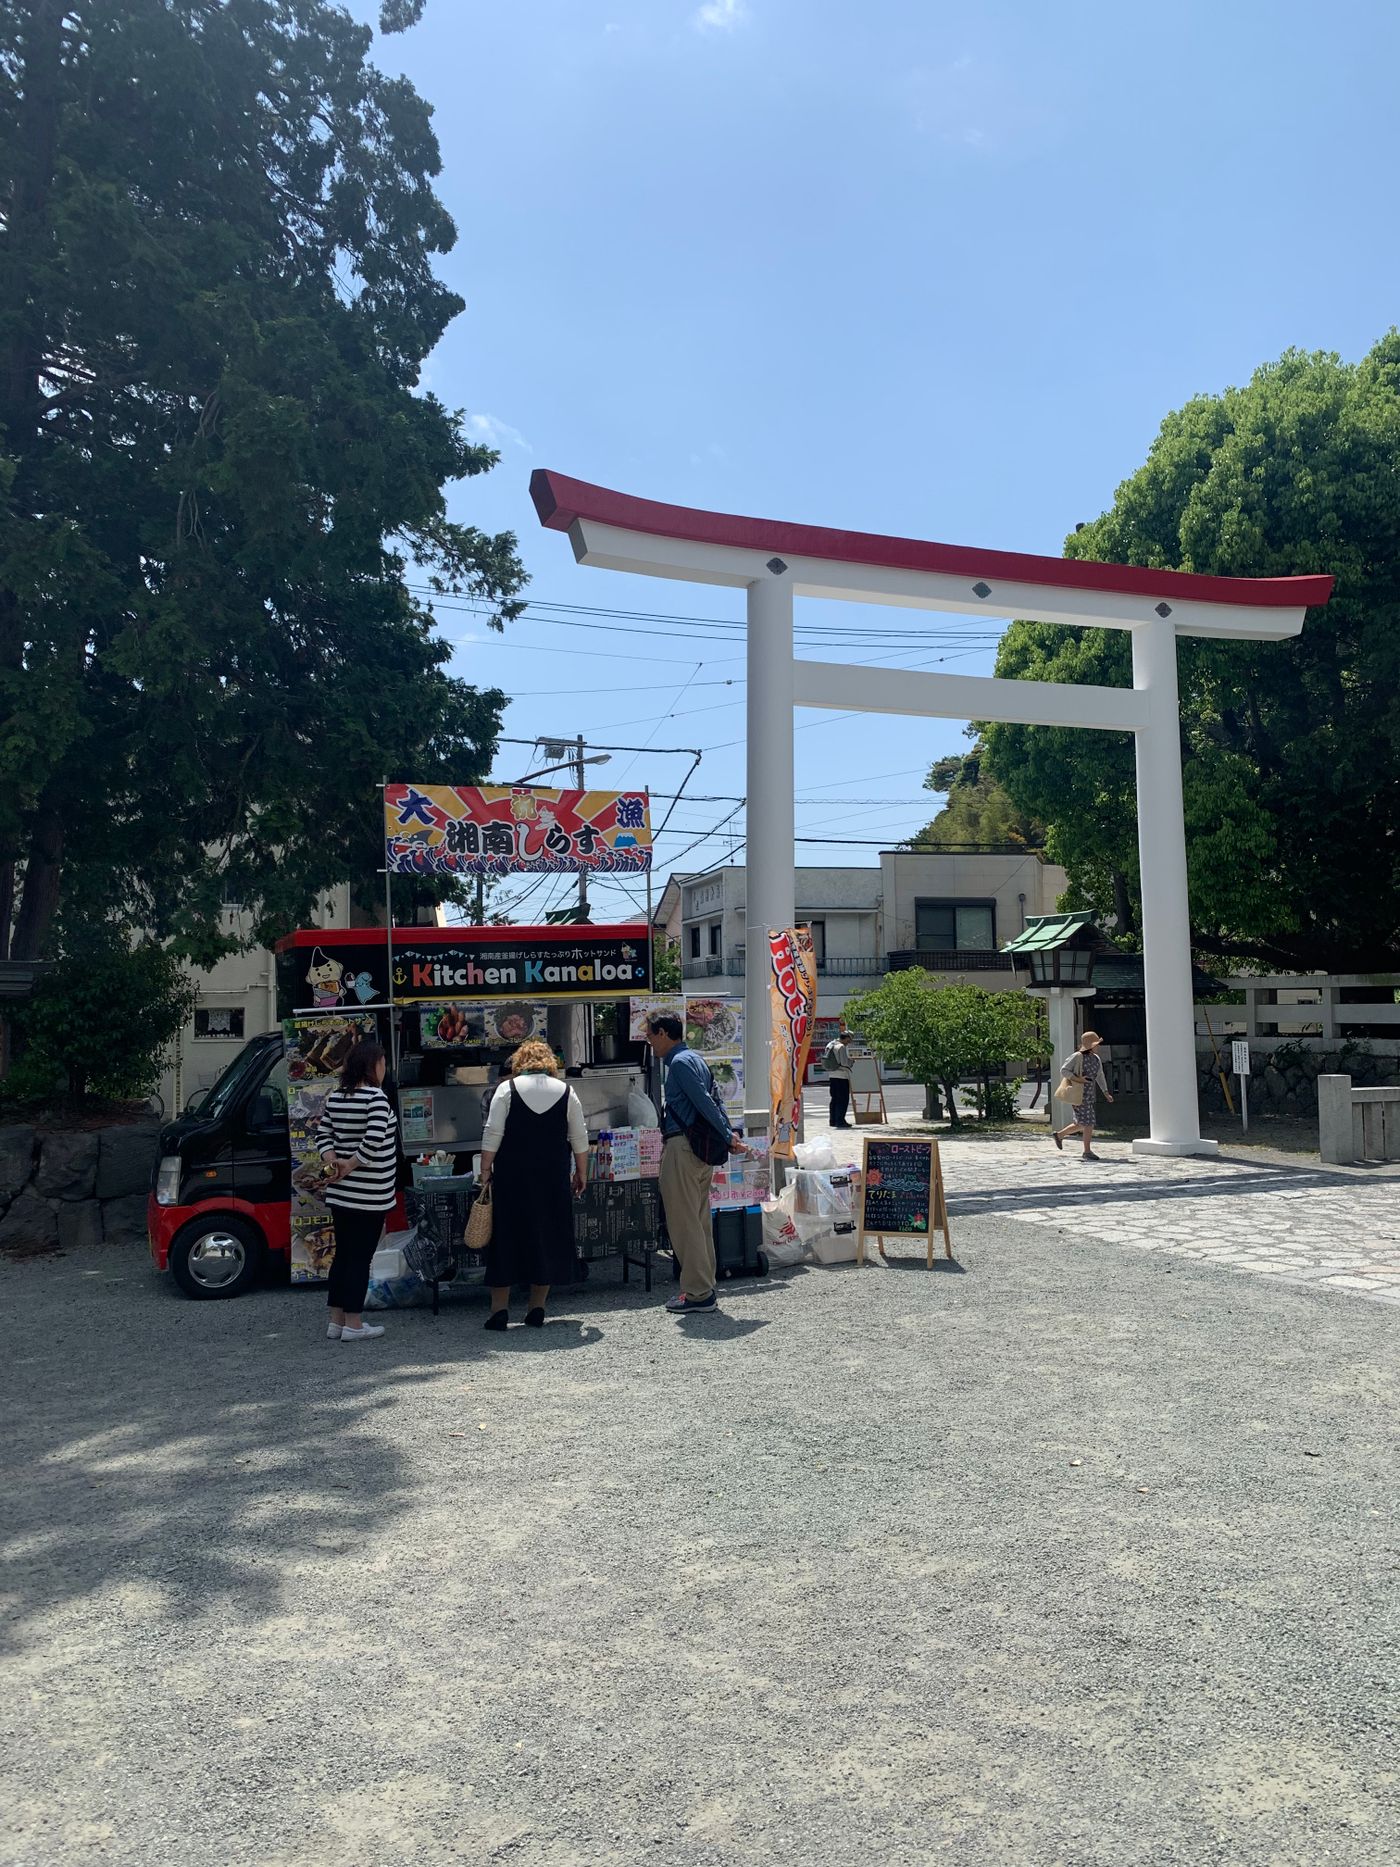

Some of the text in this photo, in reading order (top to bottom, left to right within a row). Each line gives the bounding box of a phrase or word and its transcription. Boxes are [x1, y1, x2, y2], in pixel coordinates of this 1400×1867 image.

[397, 789, 435, 824] 大
[617, 797, 645, 828] 漁
[446, 820, 599, 860] 湘南しらす
[412, 959, 633, 987] Kitchen Kanaloa
[868, 1190, 897, 1200] てりたま
[293, 1215, 334, 1226] ロコモコ
